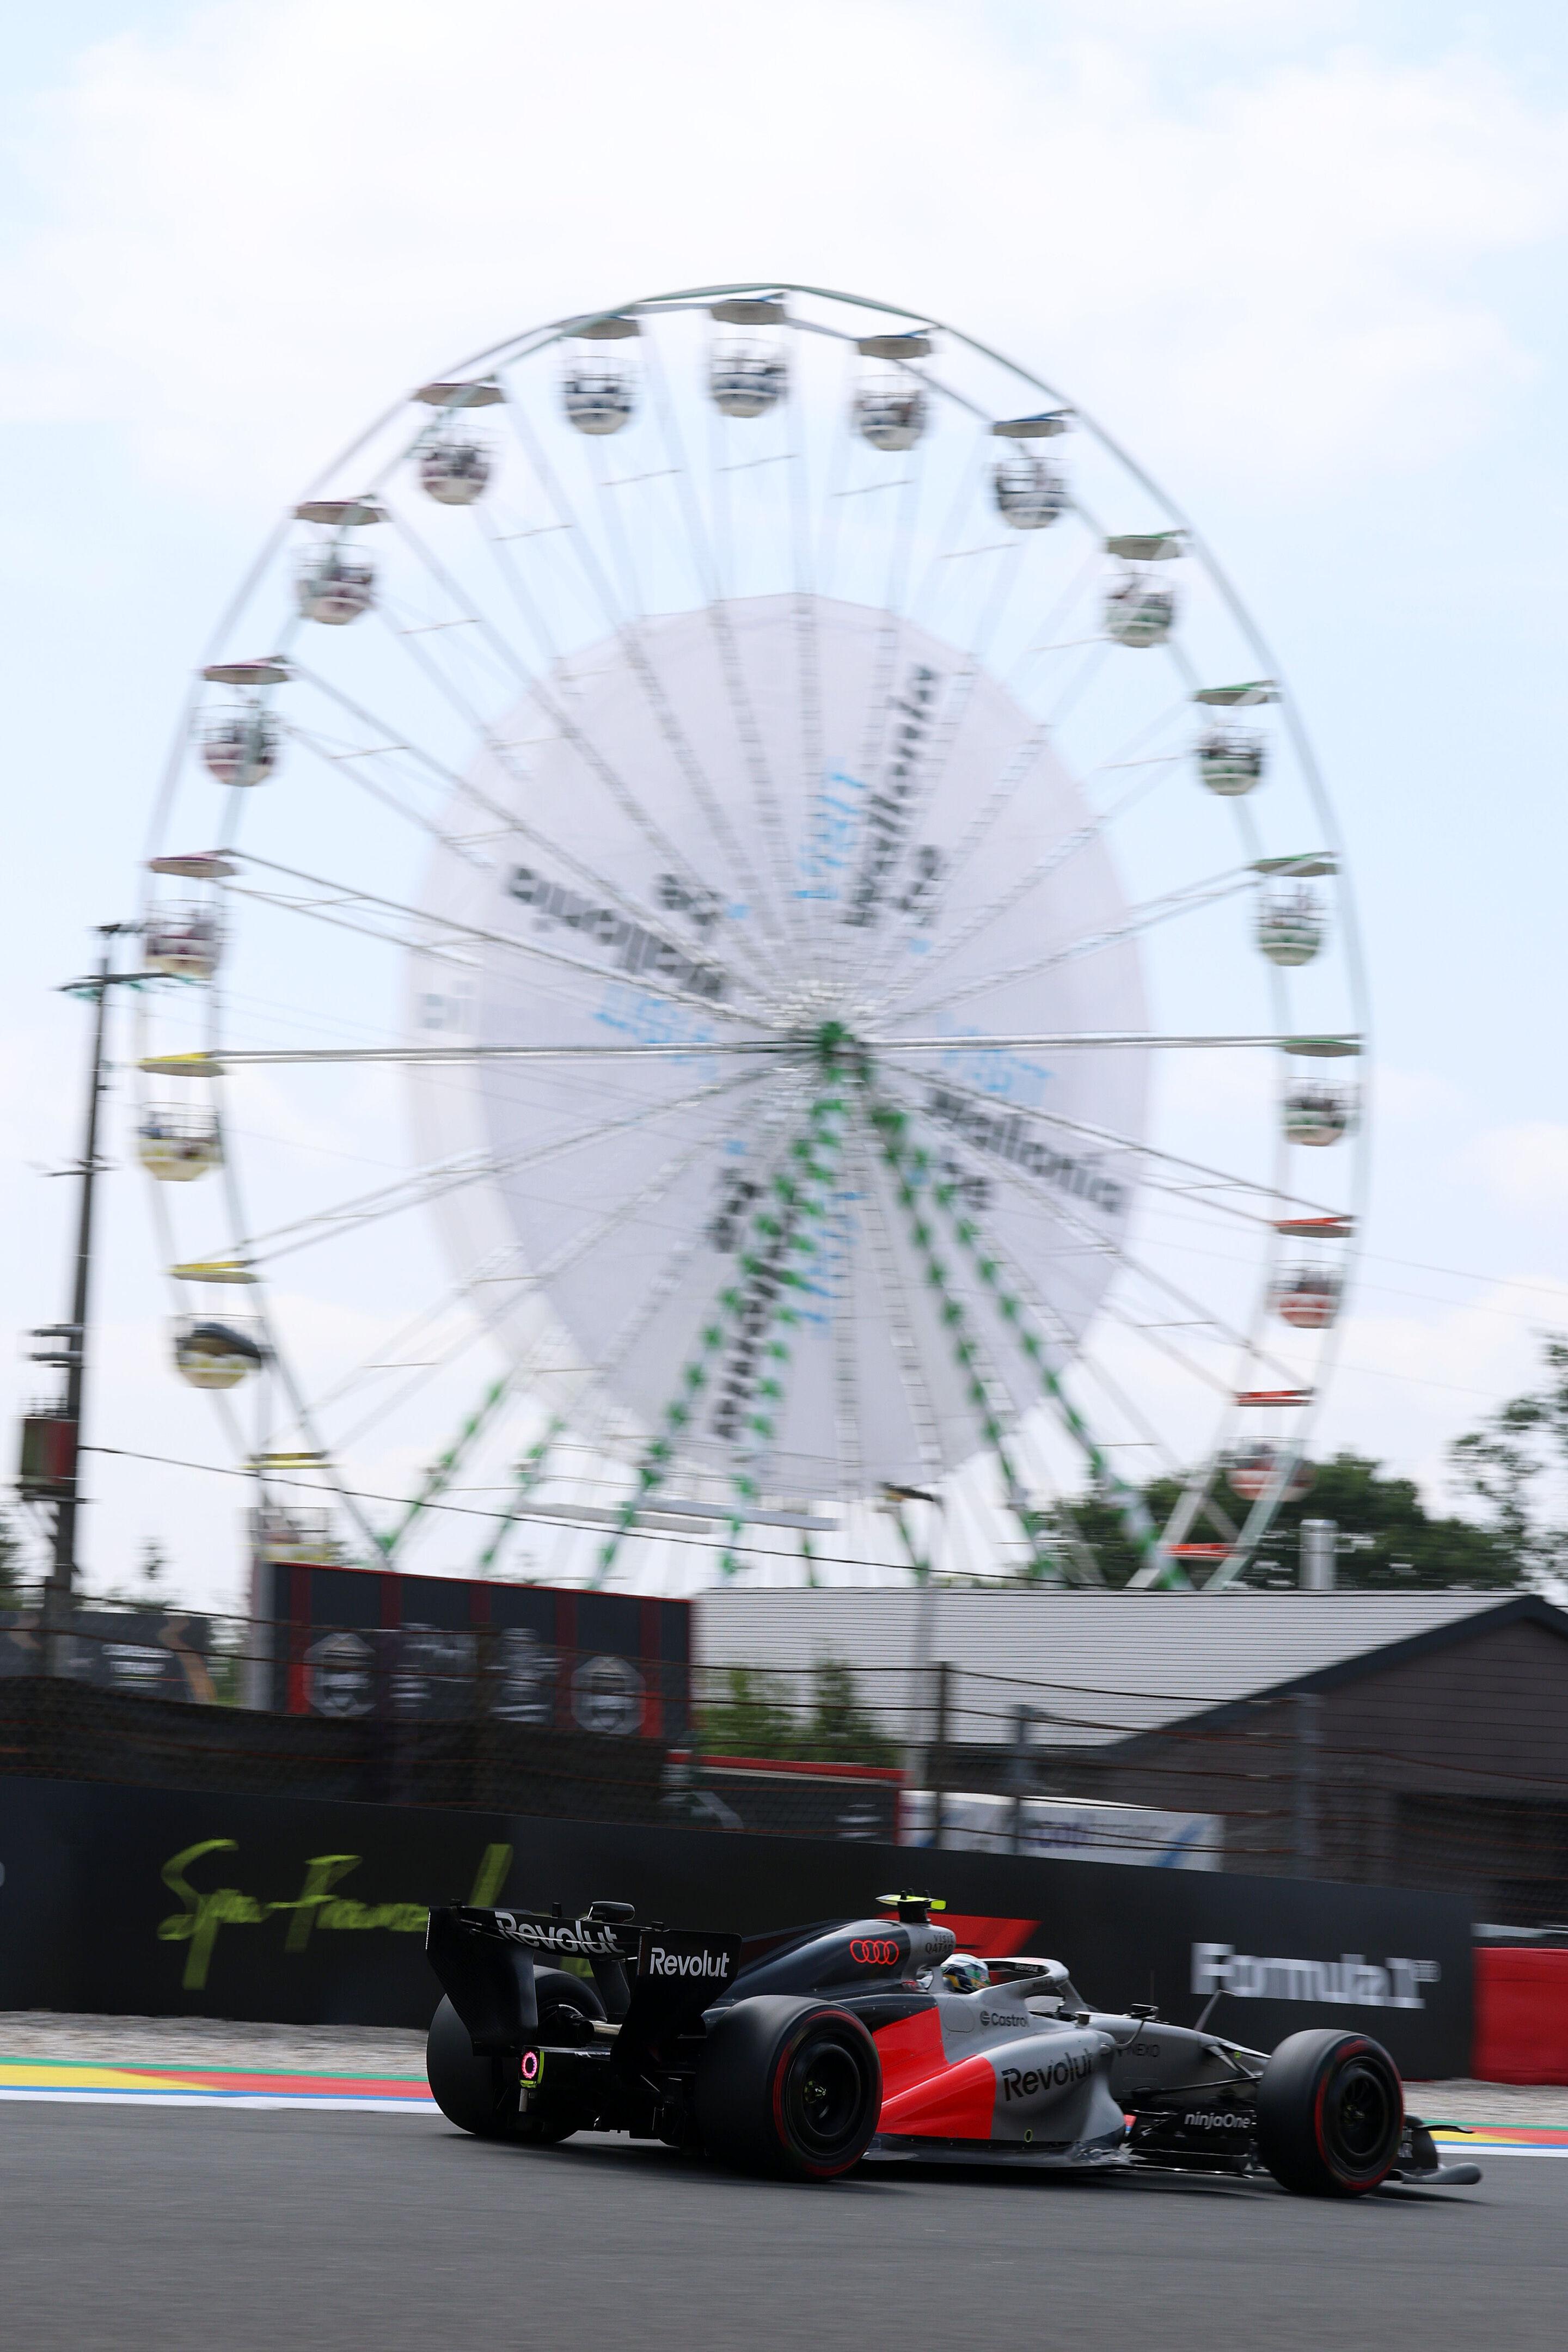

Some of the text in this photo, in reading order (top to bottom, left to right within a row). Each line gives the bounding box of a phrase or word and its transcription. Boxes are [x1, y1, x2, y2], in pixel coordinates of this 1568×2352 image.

[494, 1912, 626, 1953] Revolut
[650, 1947, 730, 1977] Revolut
[1190, 1943, 1391, 2007] Formula
[991, 2012, 1030, 2028] Castrol
[1001, 2048, 1094, 2102] Revolut
[1184, 2111, 1251, 2129] ninjaOne
